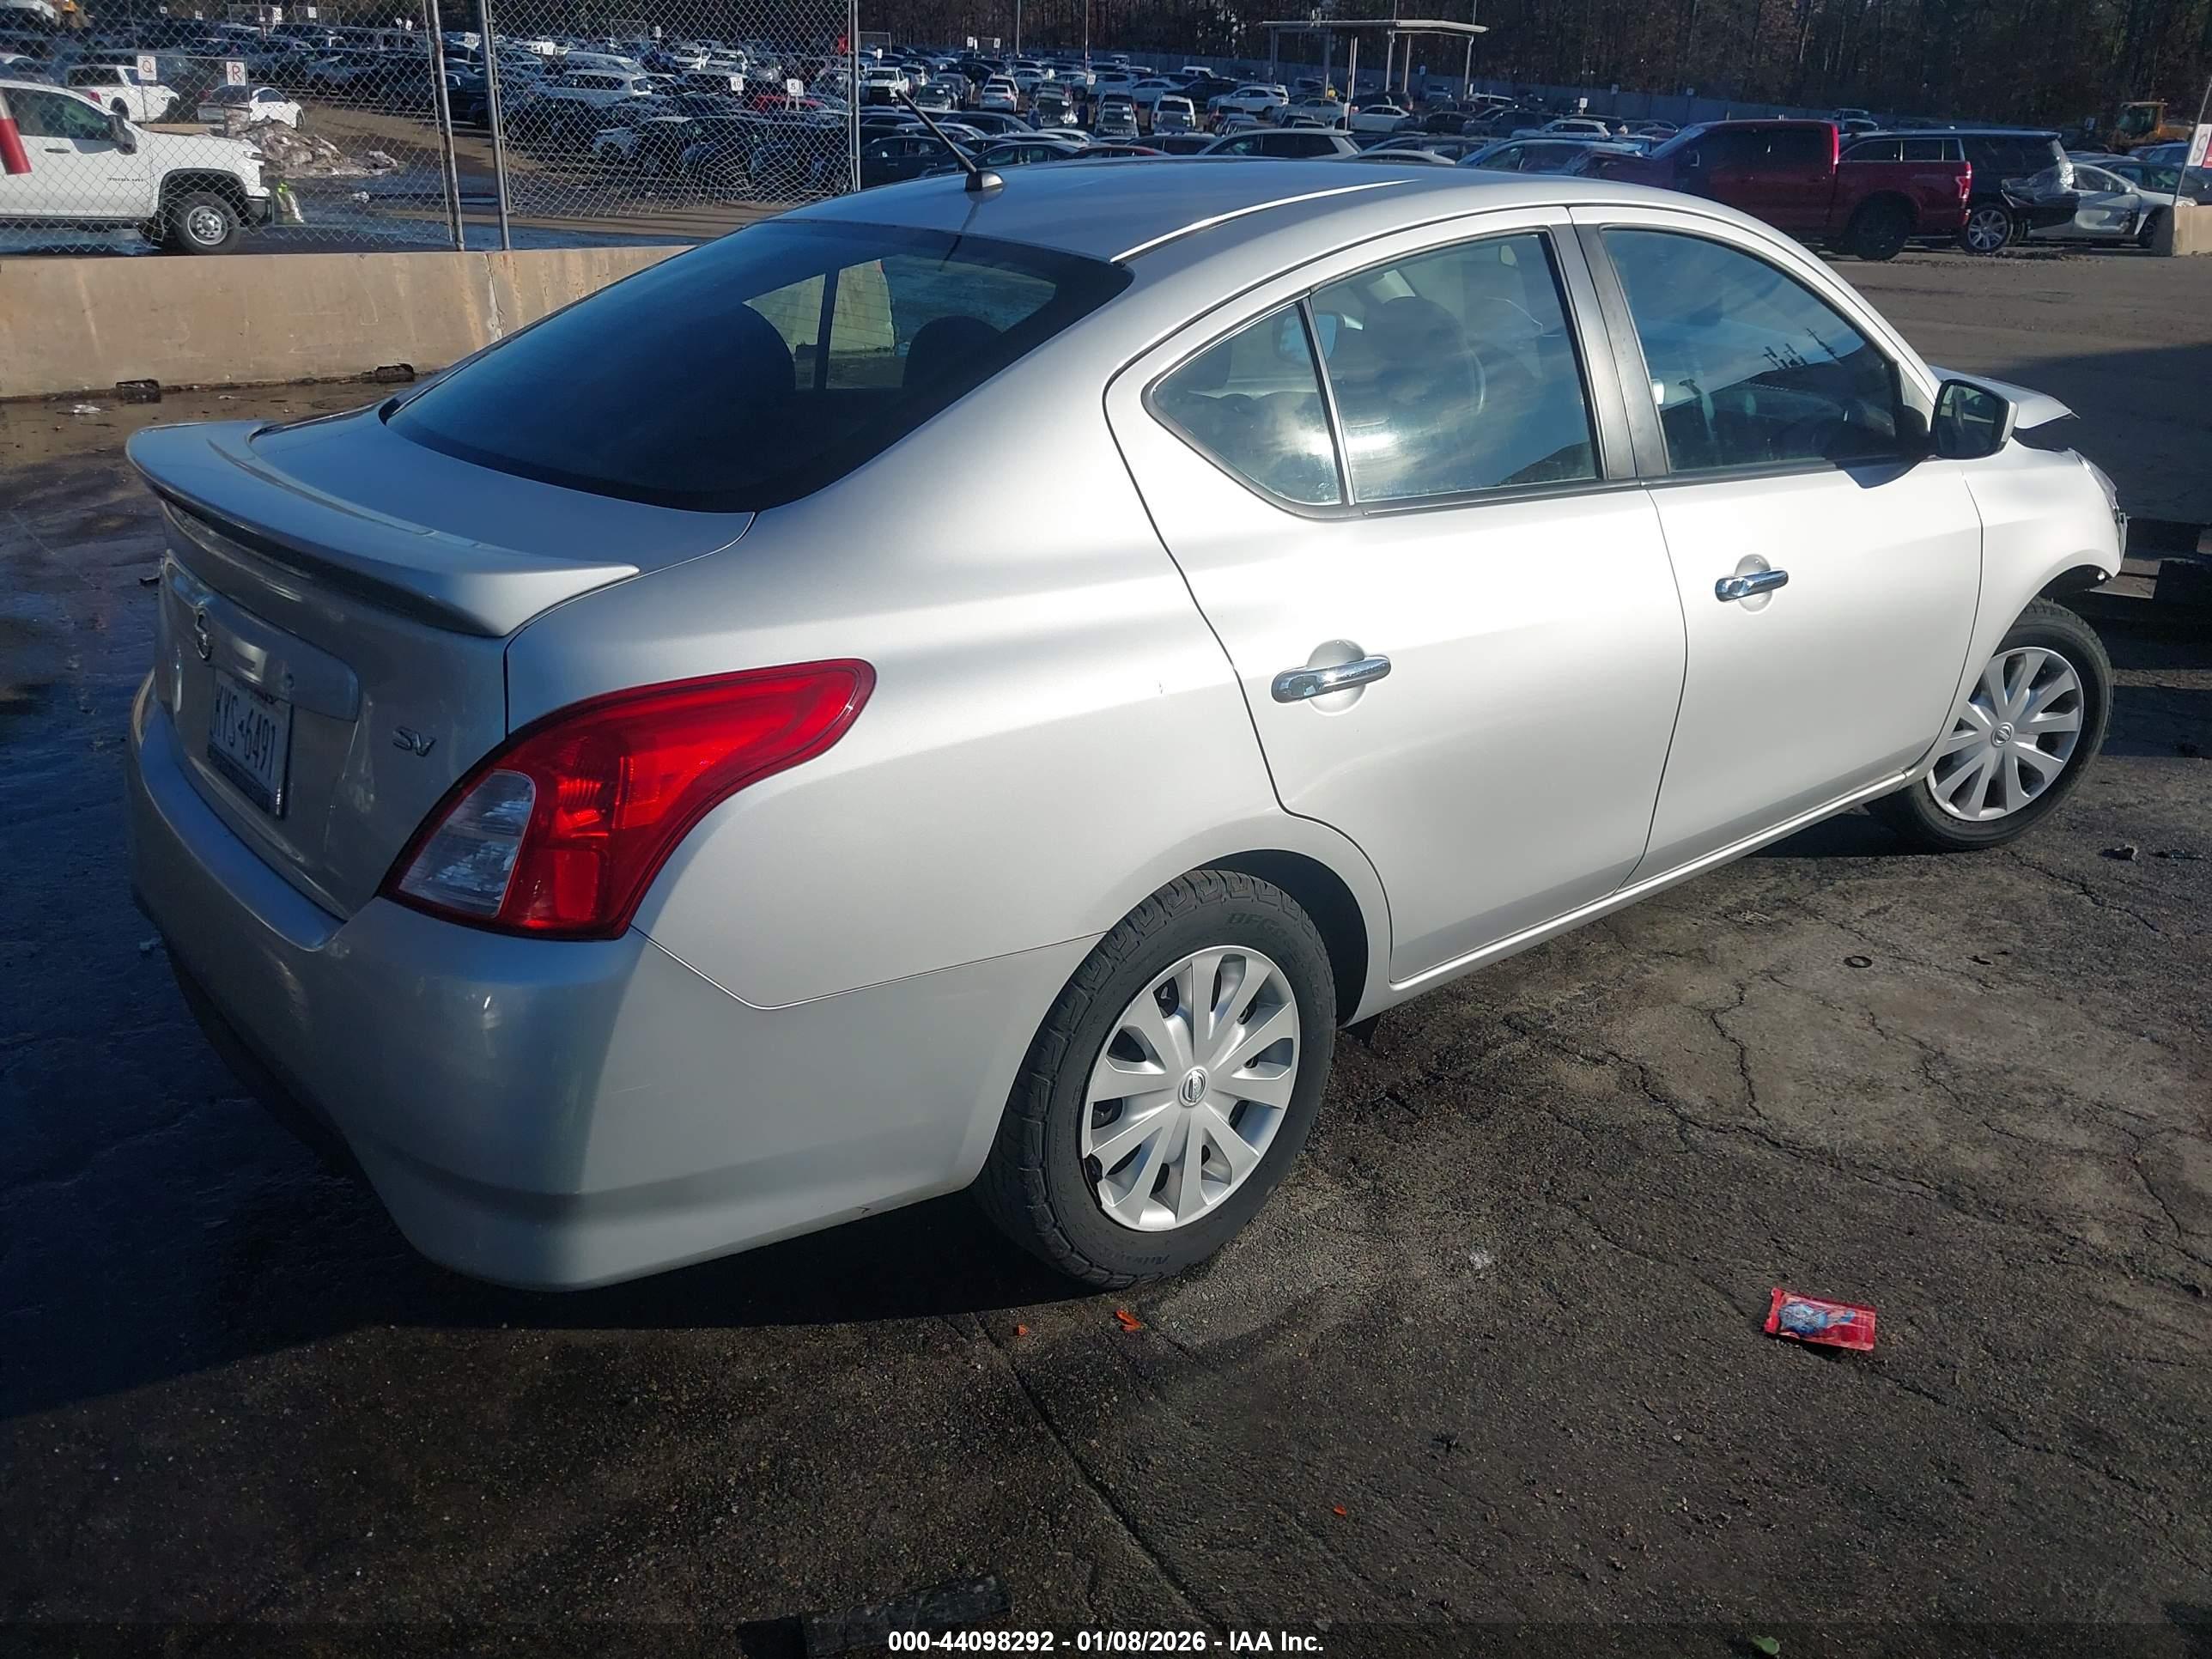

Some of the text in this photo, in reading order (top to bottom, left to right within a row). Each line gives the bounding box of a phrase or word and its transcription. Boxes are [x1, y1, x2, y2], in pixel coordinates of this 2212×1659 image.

[142, 60, 153, 73] Q
[232, 65, 242, 81] R
[392, 726, 437, 757] SV
